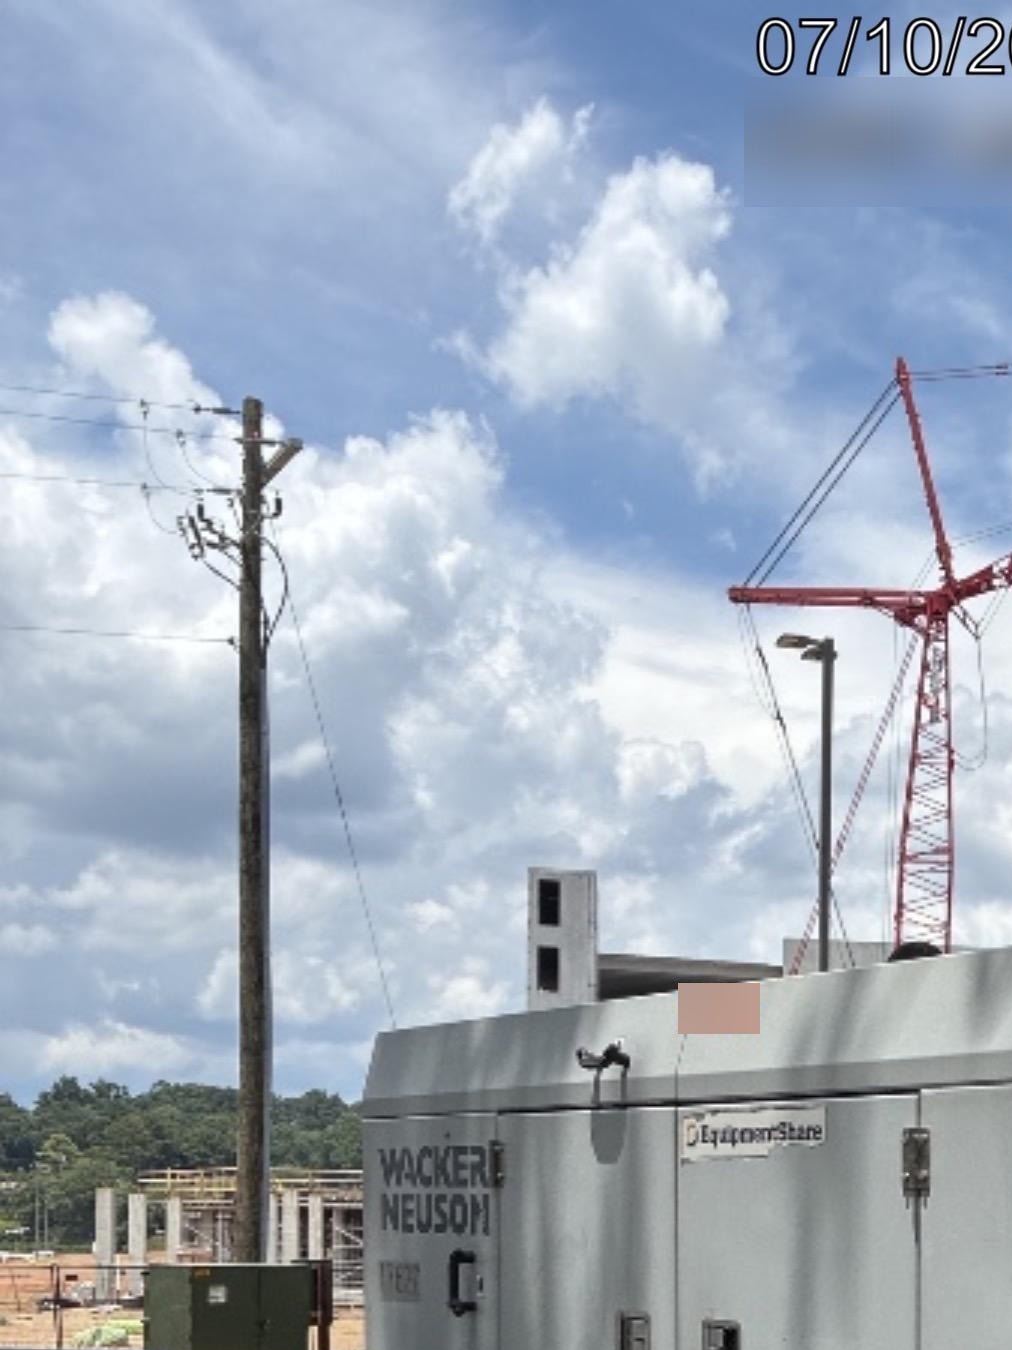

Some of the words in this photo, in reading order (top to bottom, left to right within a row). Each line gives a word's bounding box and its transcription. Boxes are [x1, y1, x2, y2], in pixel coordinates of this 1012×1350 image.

[701, 1122, 822, 1147] EquipmentShare
[378, 1145, 491, 1188] WACKER
[381, 1193, 490, 1236] NEUSON
